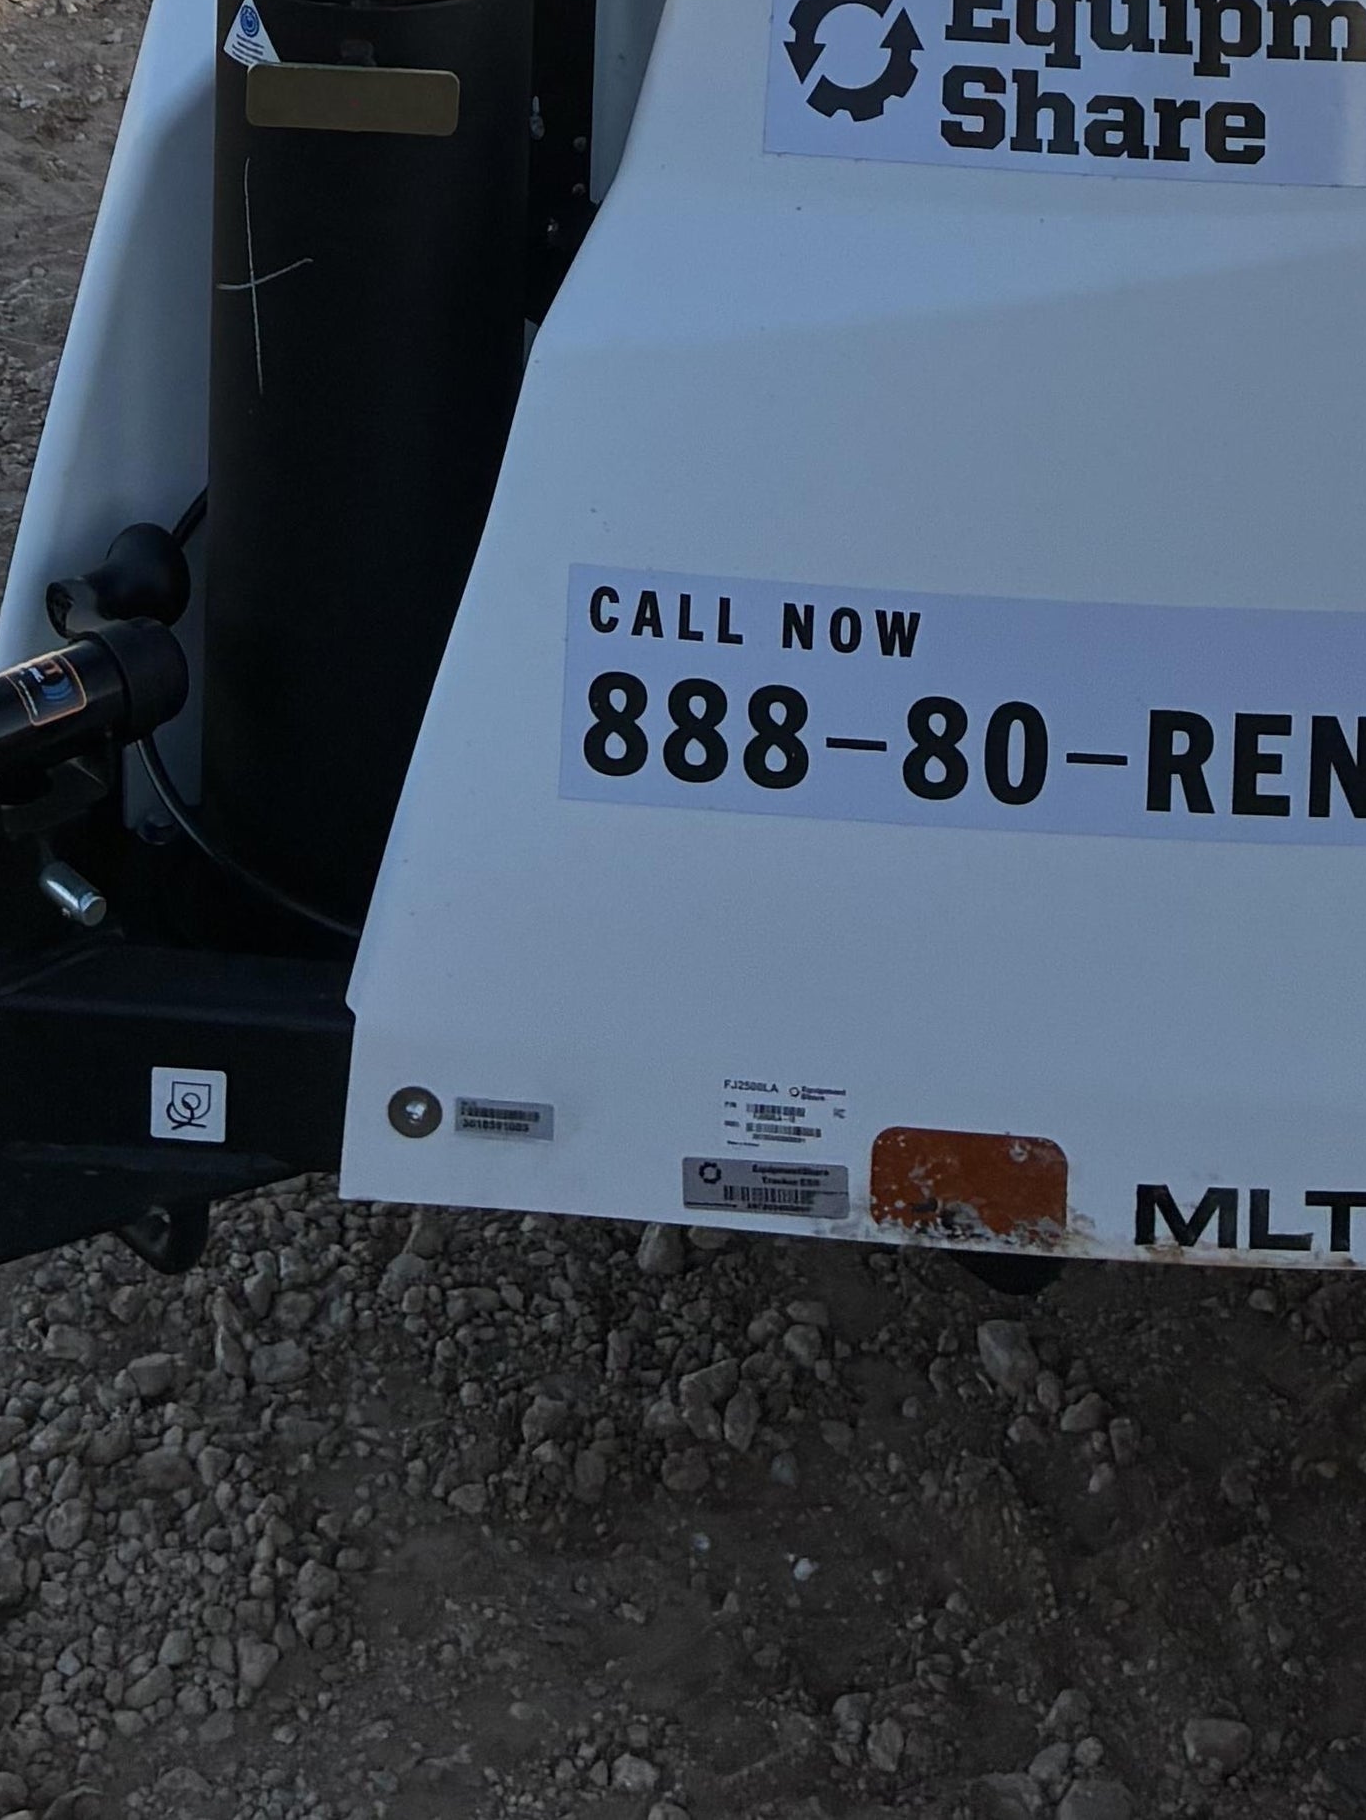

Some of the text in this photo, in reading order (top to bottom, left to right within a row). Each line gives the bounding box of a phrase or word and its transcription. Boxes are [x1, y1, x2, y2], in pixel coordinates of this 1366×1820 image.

[940, 64, 1267, 165] Share
[588, 585, 923, 659] CALL NOW
